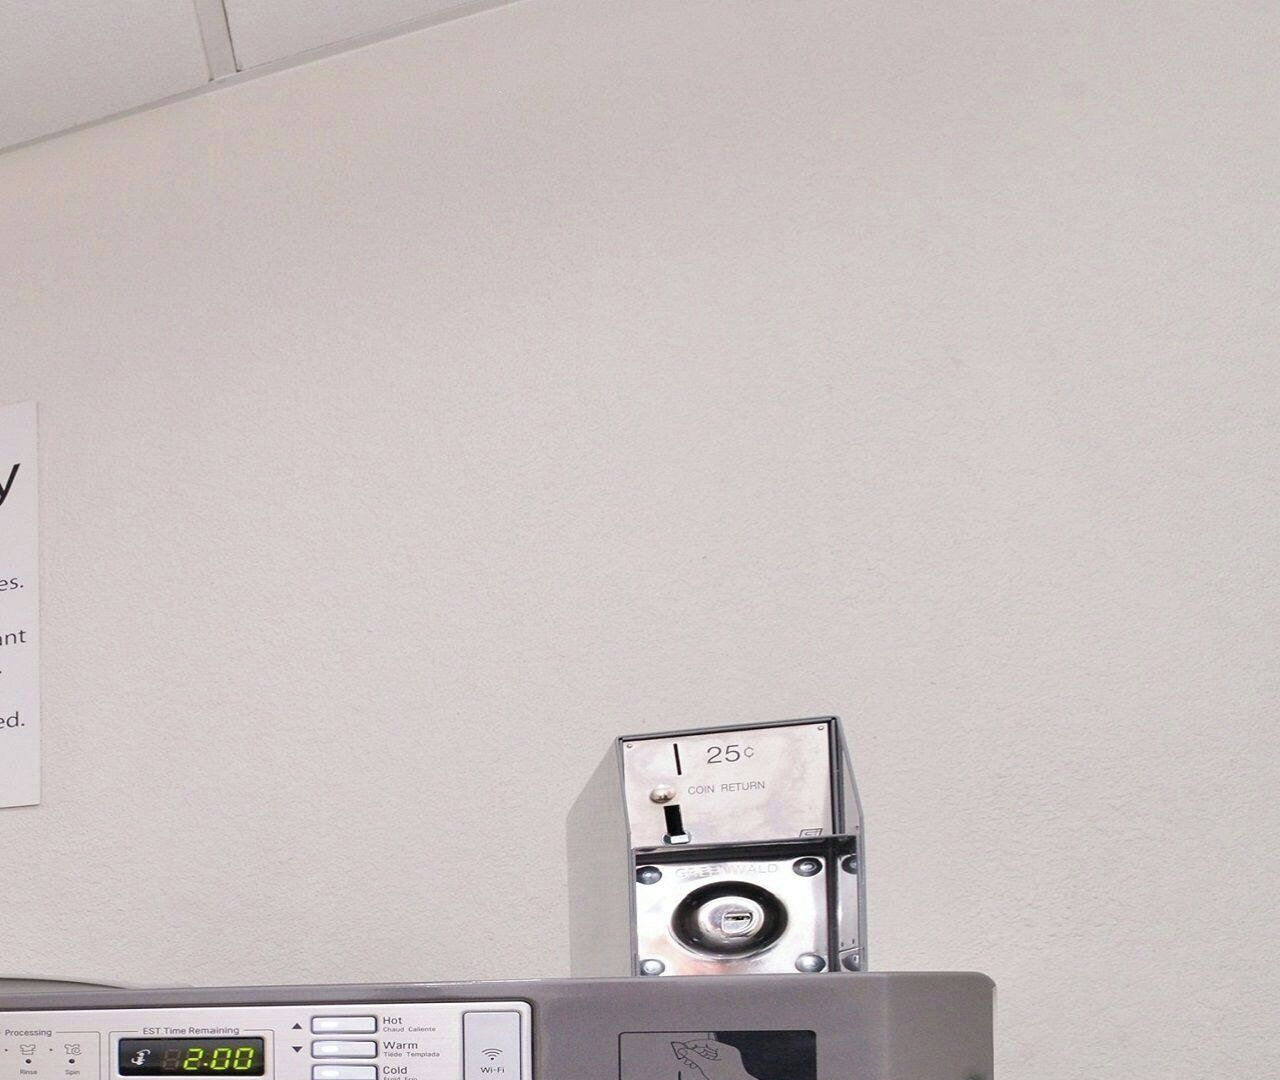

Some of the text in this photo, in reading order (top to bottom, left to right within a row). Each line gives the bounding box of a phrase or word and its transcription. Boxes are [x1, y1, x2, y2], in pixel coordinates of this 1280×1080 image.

[707, 744, 755, 765] 25¢
[688, 780, 765, 795] COIN RETURN
[383, 1017, 402, 1025] Hot
[5, 1028, 52, 1037] Processing
[163, 1027, 186, 1035] Time
[189, 1027, 240, 1036] Remaining
[383, 1041, 418, 1050] Warm
[383, 1066, 407, 1074] Cold
